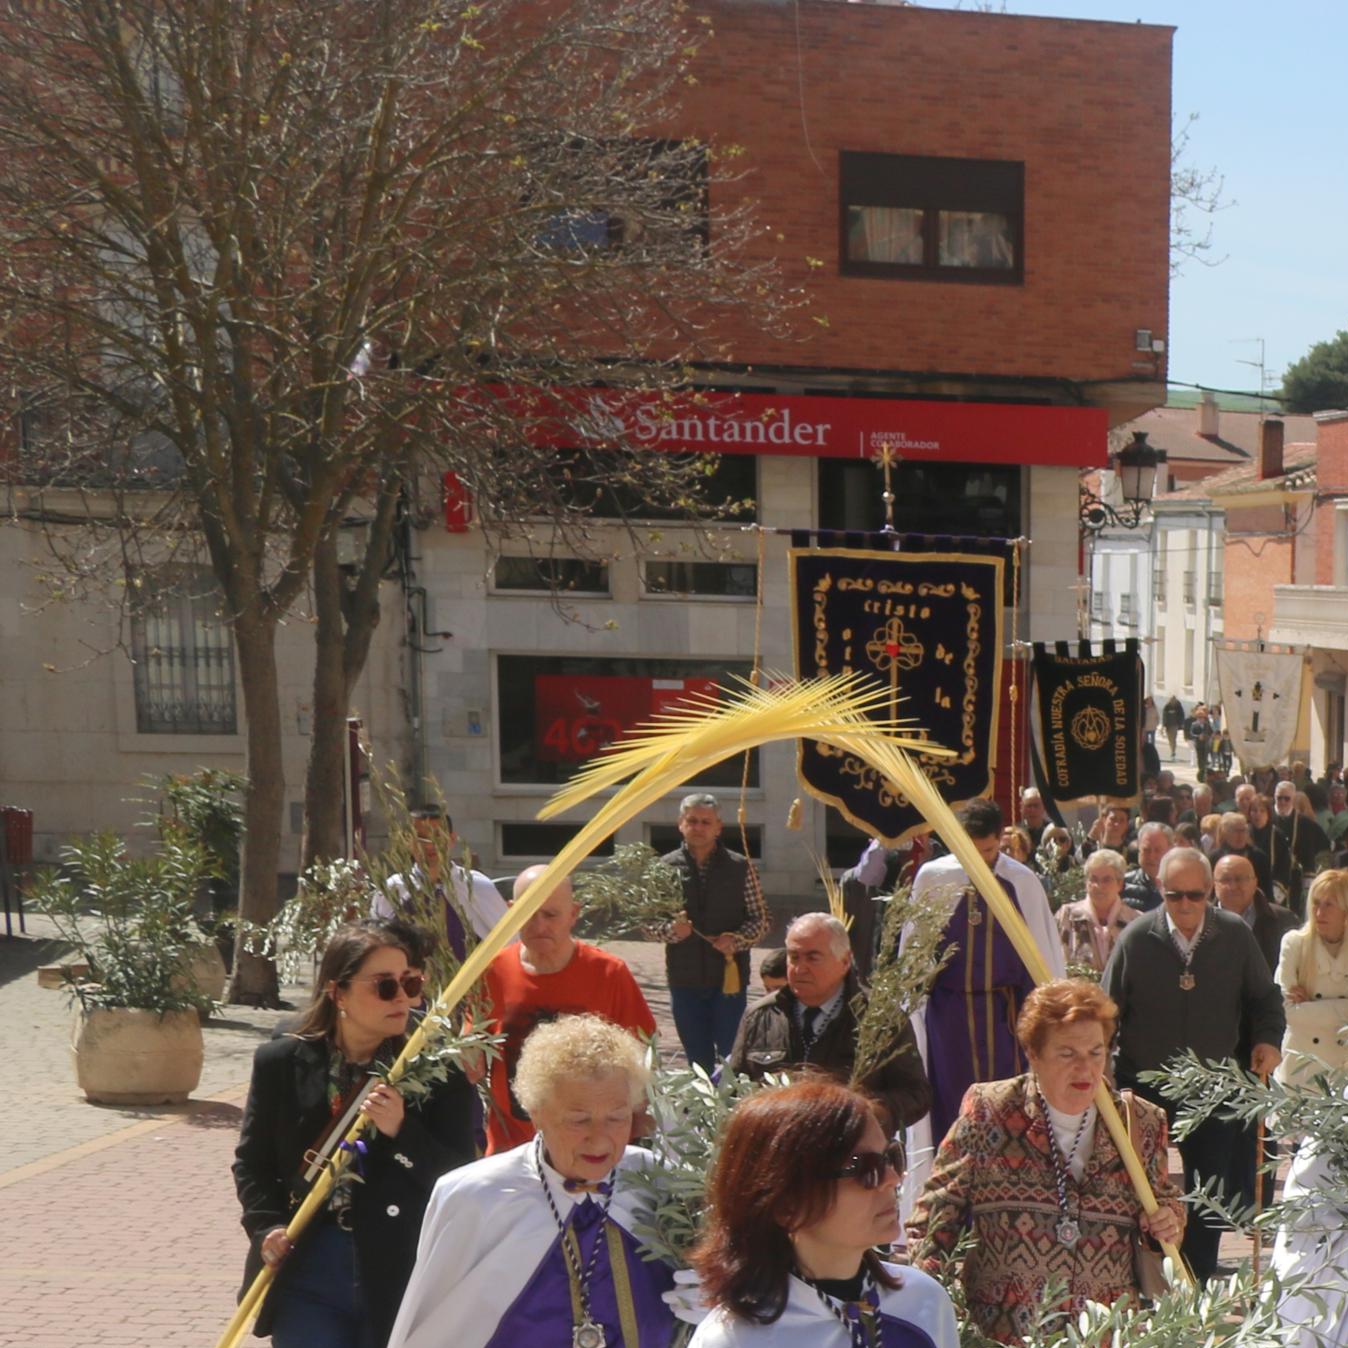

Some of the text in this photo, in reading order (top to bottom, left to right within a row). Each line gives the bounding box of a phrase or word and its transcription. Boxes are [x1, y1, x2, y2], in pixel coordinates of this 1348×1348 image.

[634, 406, 831, 446] Santander
[870, 431, 906, 441] AGENTE
[1077, 671, 1120, 697] SEÑORA
[1051, 679, 1075, 729] NUESTRA
[1112, 698, 1127, 716] DE
[1114, 717, 1127, 731] LA
[1114, 735, 1128, 786] SOLEDAD
